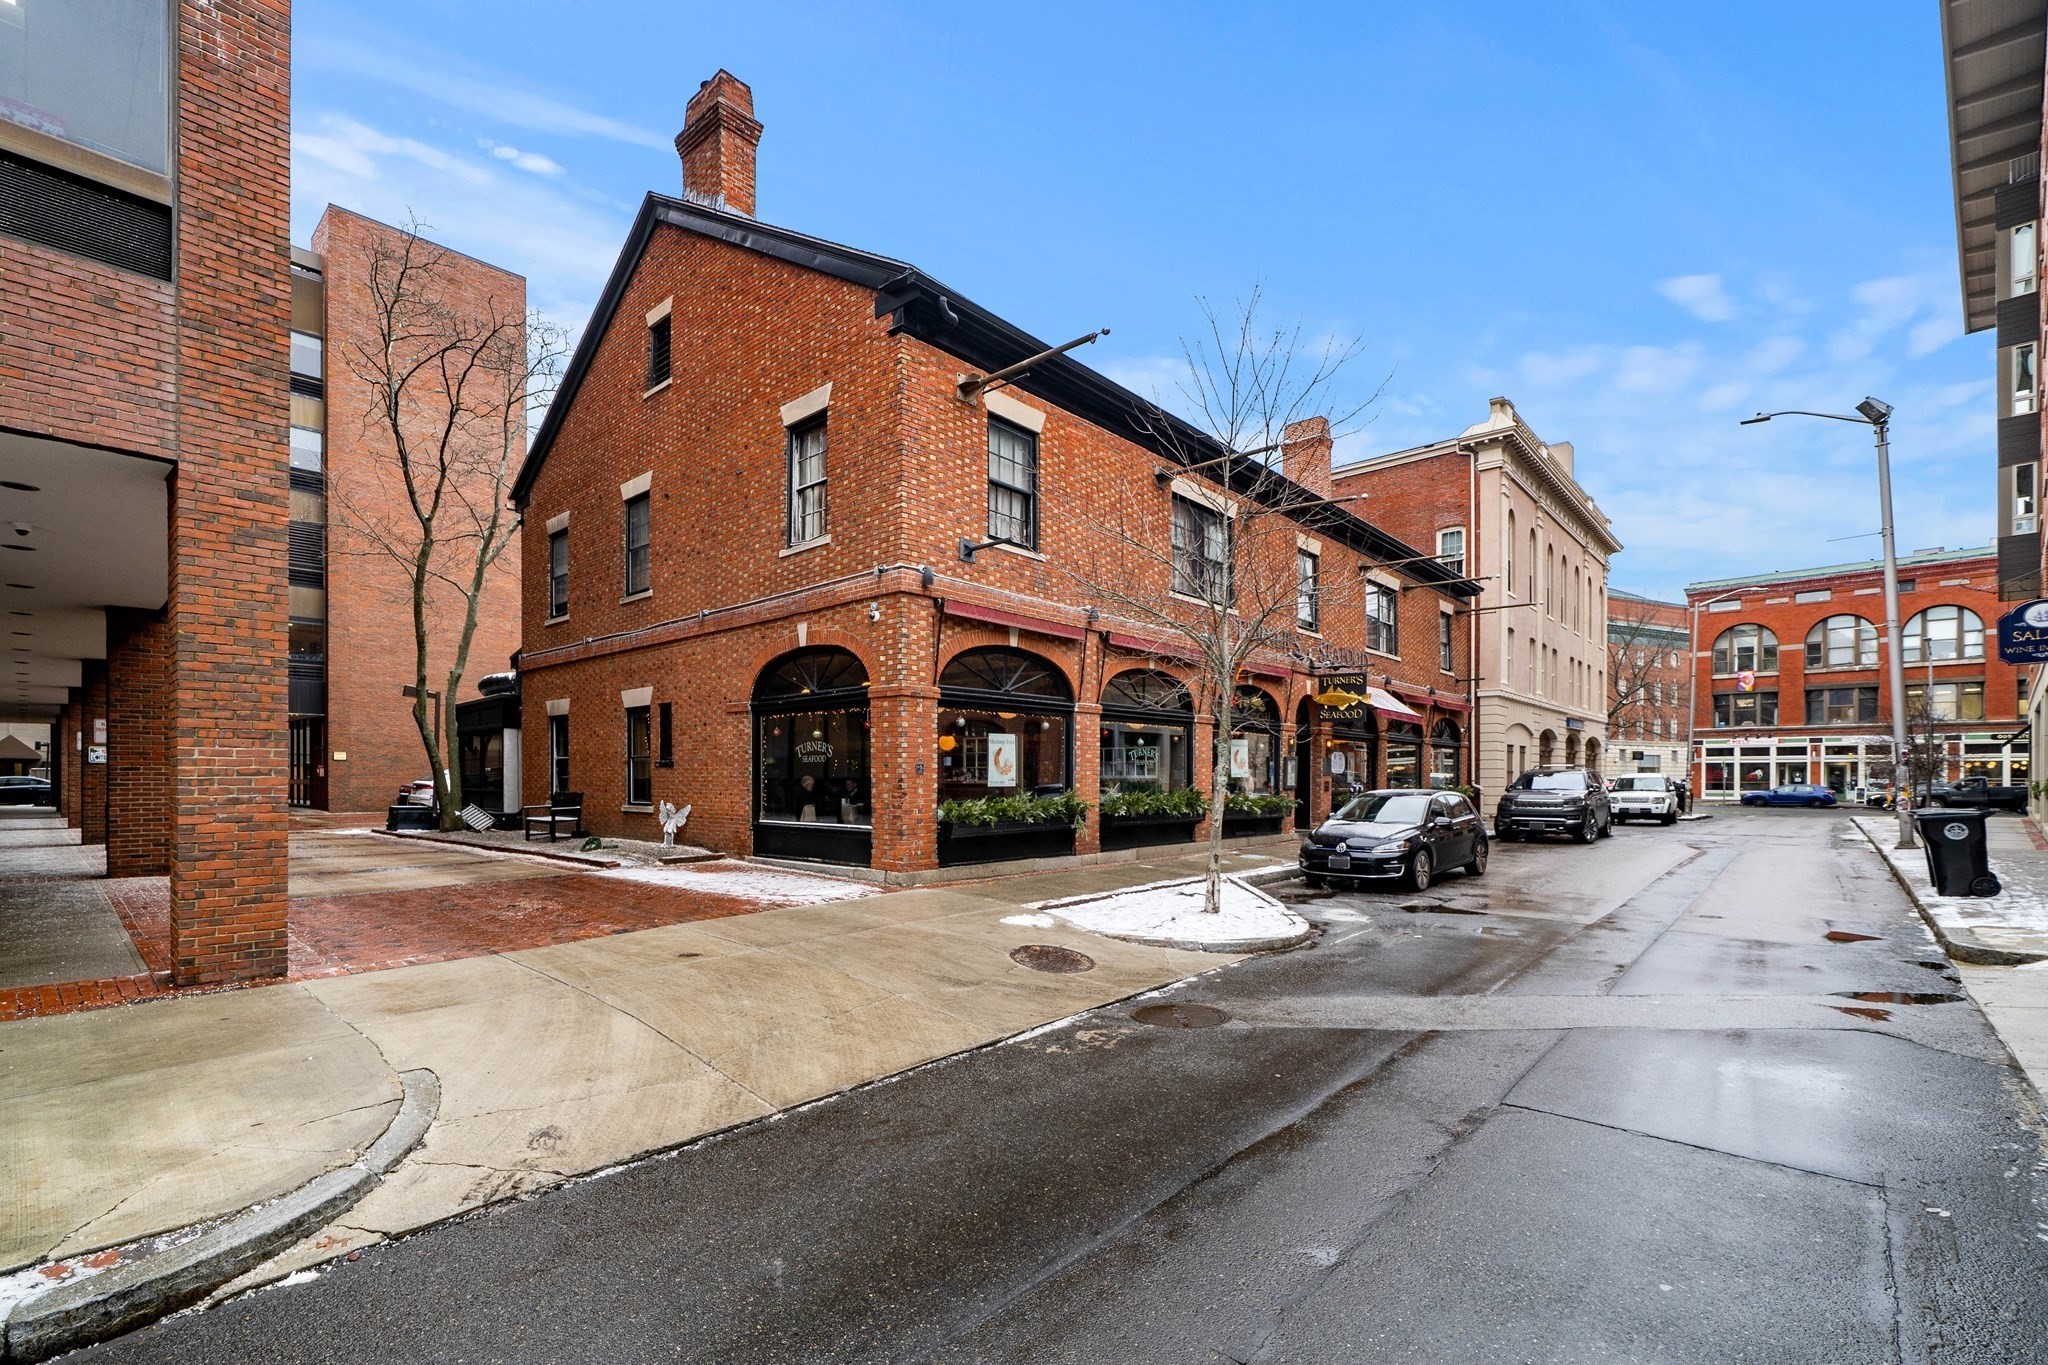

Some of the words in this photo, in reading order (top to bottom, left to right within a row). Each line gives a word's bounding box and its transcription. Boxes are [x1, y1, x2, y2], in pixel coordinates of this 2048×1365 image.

[2004, 645, 2036, 654] WINE
[1321, 675, 1364, 687] TURNER'S
[1320, 709, 1363, 719] SEAFOOD
[795, 741, 834, 757] TURNER'S
